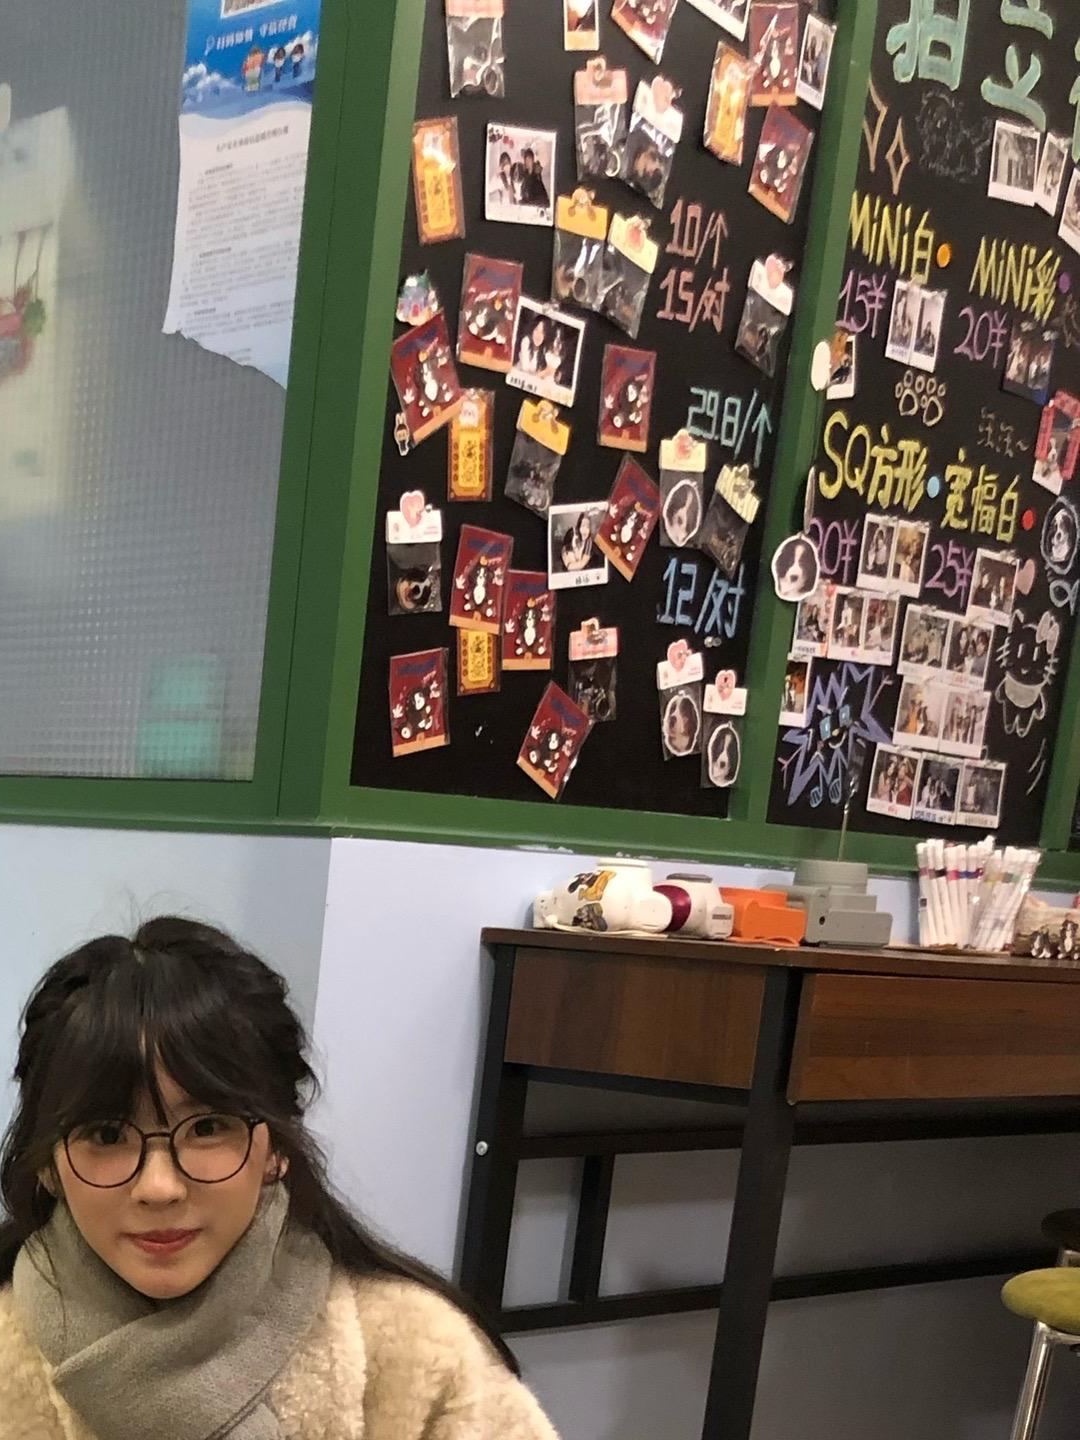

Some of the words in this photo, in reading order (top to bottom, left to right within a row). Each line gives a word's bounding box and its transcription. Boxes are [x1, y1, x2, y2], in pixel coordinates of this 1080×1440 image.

[656, 267, 730, 333] 15/对
[953, 306, 1008, 368] 20¥
[819, 410, 929, 513] SQ方形
[941, 447, 1021, 543] 宽幅白
[657, 557, 746, 638] 12/对
[925, 539, 974, 609] 25¥
